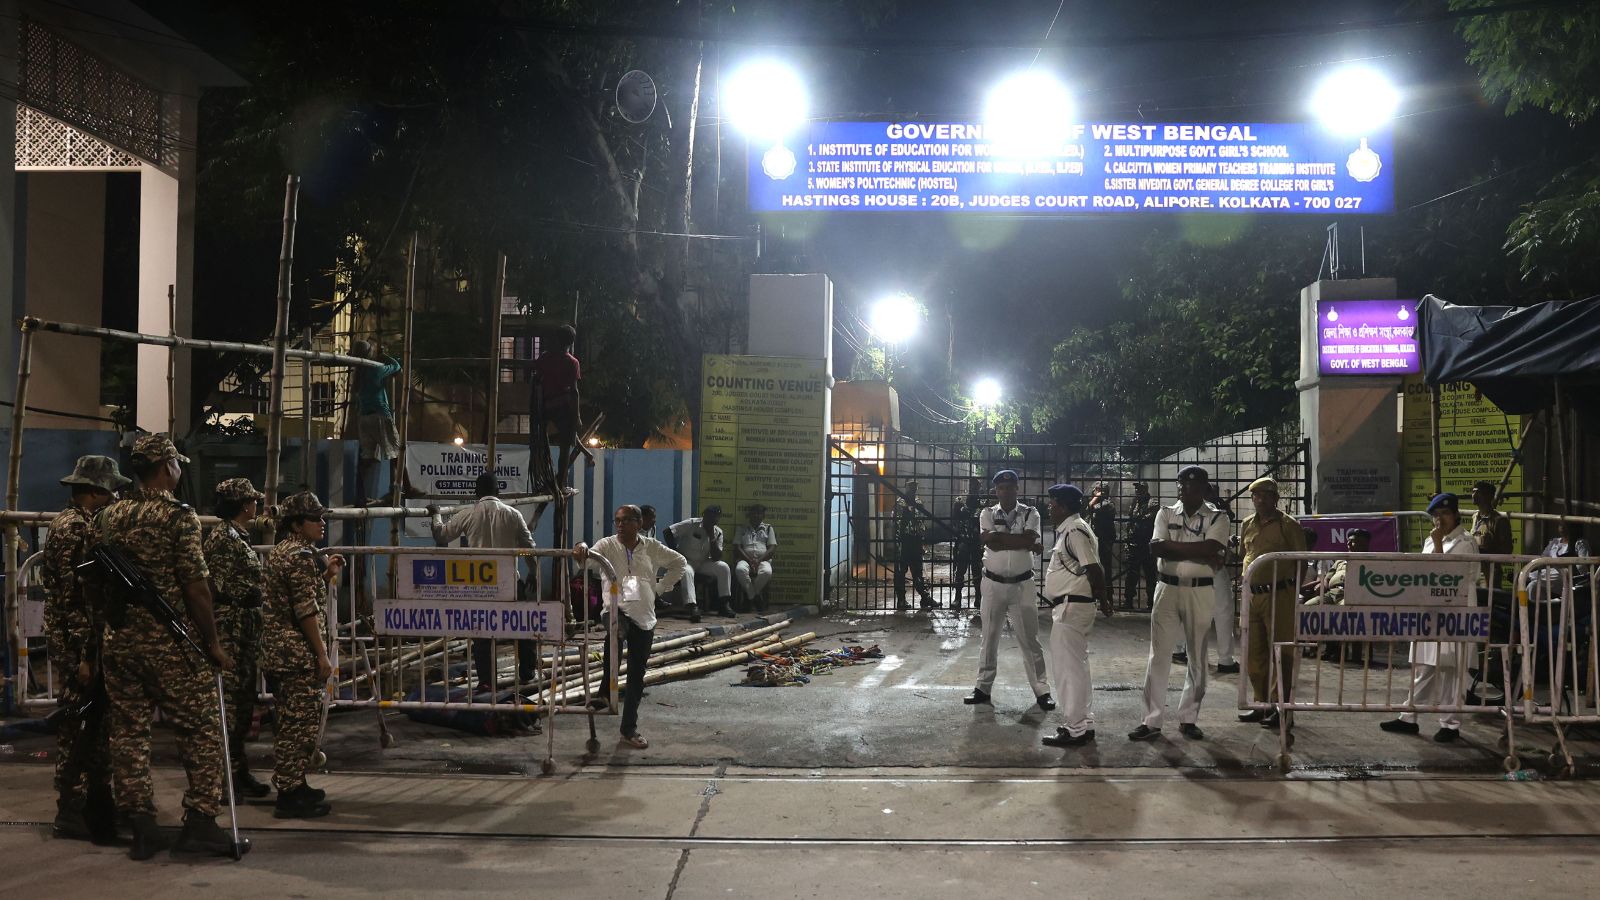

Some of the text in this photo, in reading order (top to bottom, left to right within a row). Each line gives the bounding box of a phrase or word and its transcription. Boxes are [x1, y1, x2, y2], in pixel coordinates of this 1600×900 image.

[1091, 125, 1157, 140] WEST
[1163, 125, 1257, 141] BENGAL
[819, 144, 872, 156] INSTITUTE
[874, 144, 888, 155] OF
[891, 144, 949, 156] EDUCATION
[951, 144, 973, 156] FOR
[1115, 145, 1187, 157] MULTIPURPOSE
[1189, 145, 1216, 157] GOVT.
[1219, 145, 1248, 157] GIRL'S
[1251, 145, 1289, 157] SCHOOL
[817, 161, 840, 173] STATE
[842, 161, 881, 173] INSTITUTE
[883, 161, 893, 173] OF
[894, 161, 930, 173] PHYSICAL
[932, 161, 974, 173] EDUCATION
[976, 161, 993, 174] FOR
[1113, 162, 1152, 174] CALCUTTA
[1154, 162, 1182, 174] WOMEN
[1184, 162, 1217, 174] PRIMARY
[1219, 162, 1257, 174] TEACHERS
[1259, 162, 1295, 175] TRAINING
[1296, 163, 1335, 175] INSTITUTE
[816, 177, 855, 189] WOMEN'S
[857, 177, 916, 189] POLYTECHNIC
[918, 177, 957, 191] (HOSTEL)
[1138, 178, 1171, 190] NIVEDITA
[1173, 179, 1194, 190] GOVT.
[1196, 179, 1229, 191] GENERAL
[1231, 179, 1259, 191] DEGREE
[1261, 179, 1293, 191] COLLEGE
[1295, 180, 1309, 191] FOR
[782, 195, 860, 206] HASTINGS
[864, 195, 917, 206] HOUSE
[931, 195, 964, 207] 20B,
[968, 195, 1030, 207] JUDGES
[1035, 195, 1088, 208] COURT
[1092, 196, 1139, 209] ROAD,
[1144, 196, 1214, 209] ALIPORE.
[1219, 197, 1290, 209] KOLKATA
[1303, 197, 1332, 209] 700
[1334, 197, 1361, 209] 027
[1330, 358, 1408, 368] GOVT. OF WEST BENGAL
[707, 375, 821, 392] COUNTING VENUE
[441, 452, 488, 464] TRAINING
[421, 464, 463, 476] POLLING
[452, 562, 494, 584] LIC
[1430, 588, 1459, 597] REALTY
[385, 608, 547, 632] KOLKATA TRAFFIC POLICE
[1300, 611, 1490, 637] KOLKATA TRAFFIC POLICE
